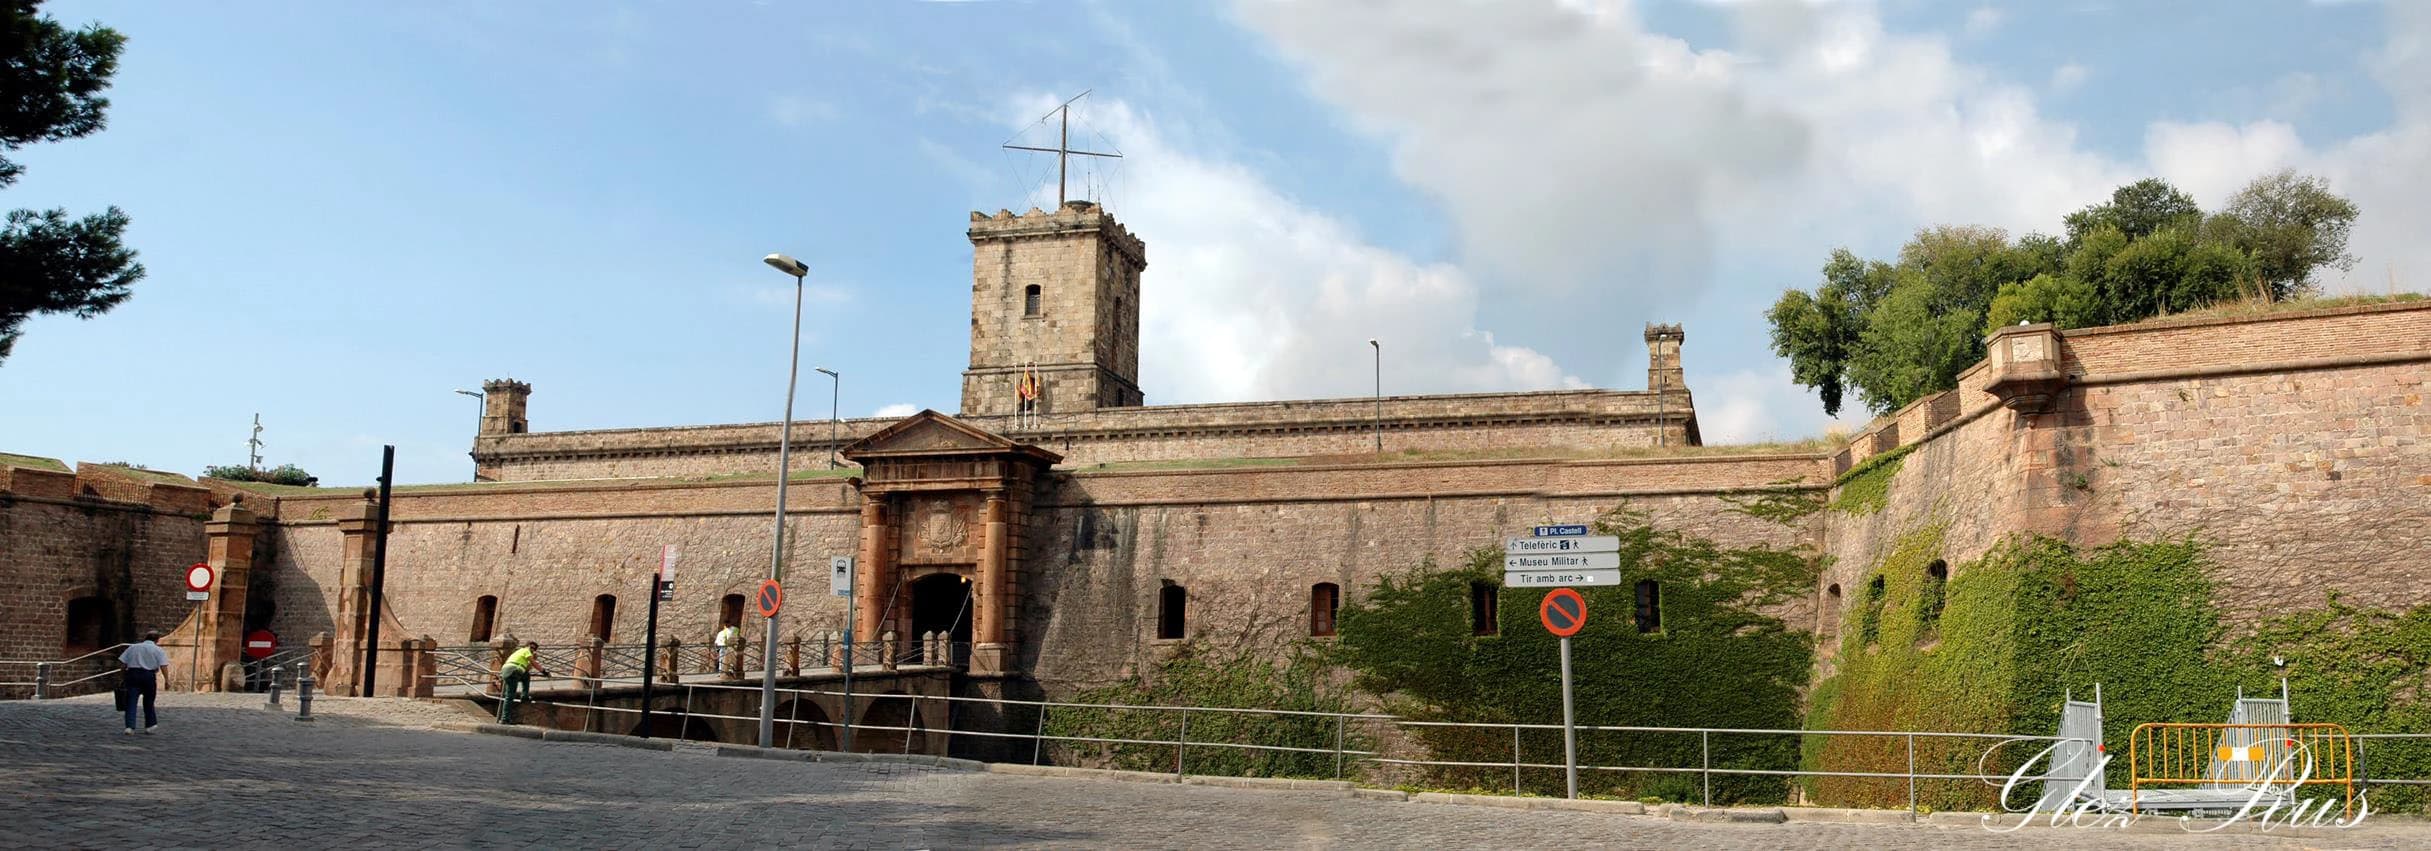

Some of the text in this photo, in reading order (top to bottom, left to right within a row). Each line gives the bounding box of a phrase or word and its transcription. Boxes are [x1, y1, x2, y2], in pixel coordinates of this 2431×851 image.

[1550, 527, 1582, 535] Pl. Castell
[1520, 540, 1558, 550] Telefèric
[1520, 556, 1579, 567] Museu Militar
[1520, 573, 1573, 583] Tir amb arc
